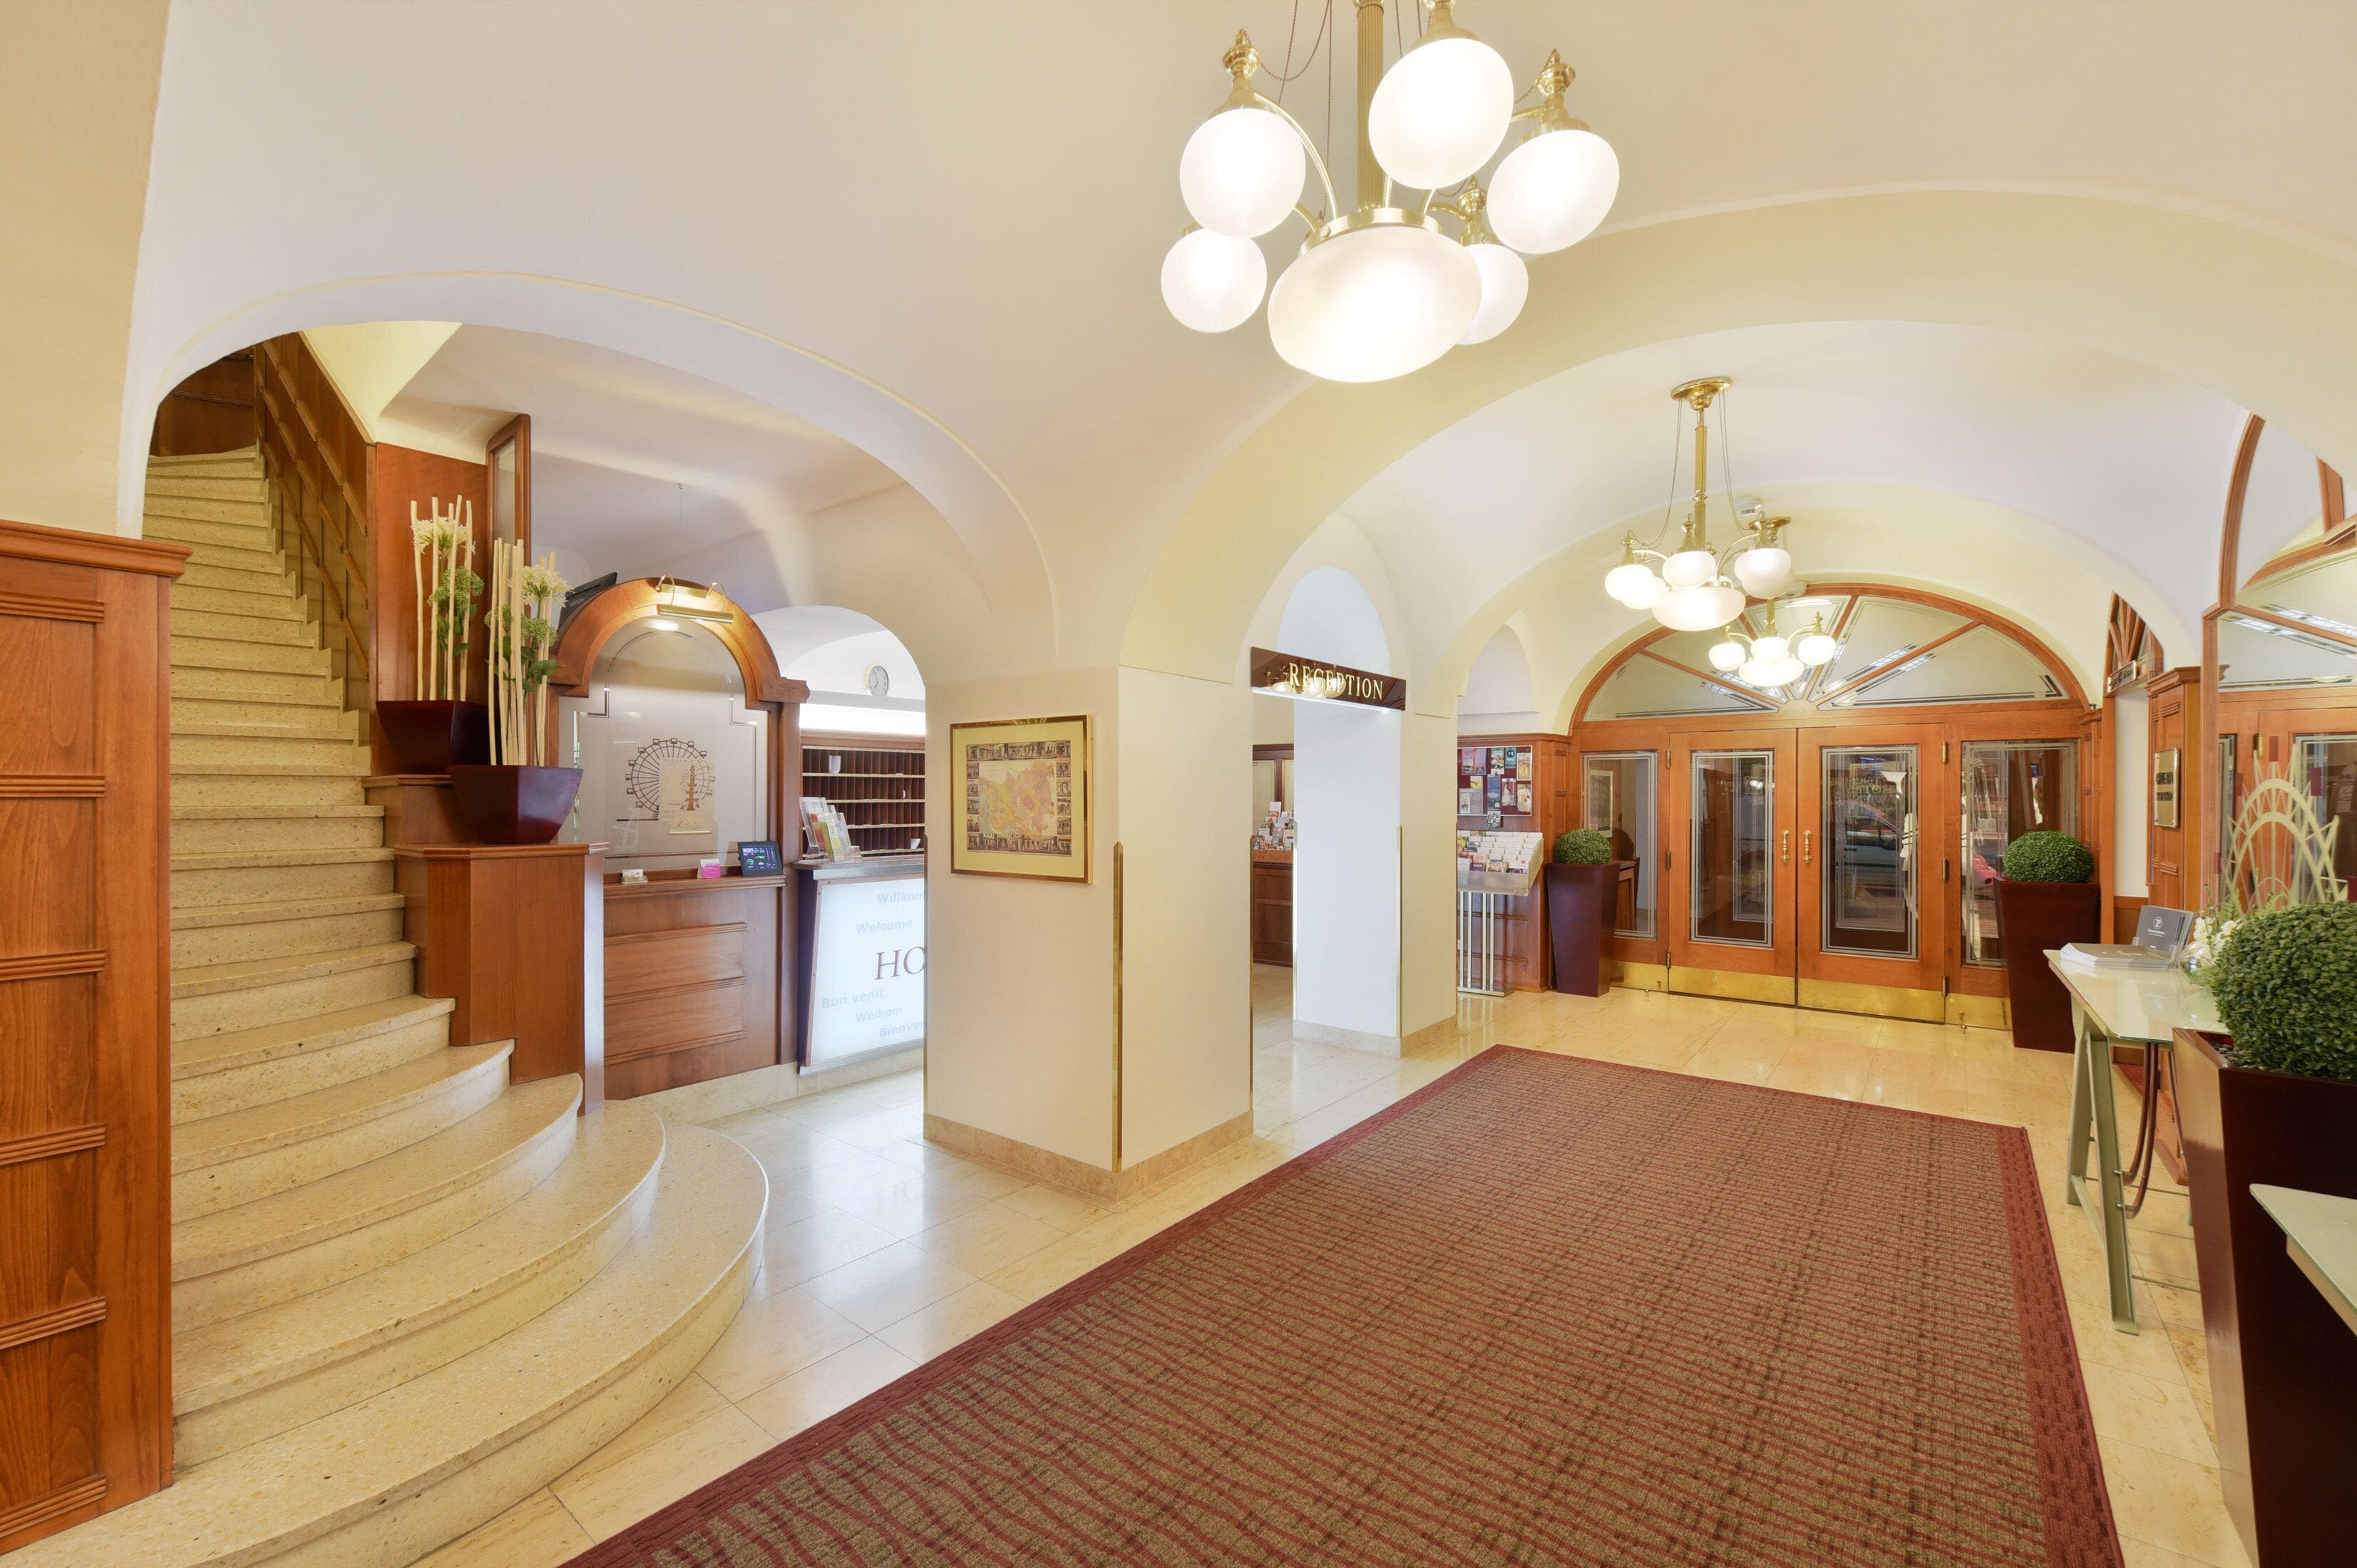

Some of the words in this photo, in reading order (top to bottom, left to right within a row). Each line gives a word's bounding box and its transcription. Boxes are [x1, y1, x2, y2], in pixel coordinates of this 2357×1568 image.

[1289, 663, 1383, 700] RECEPTION
[856, 919, 913, 934] Welcome
[874, 947, 924, 980] HO
[821, 996, 847, 1009] Bun
[853, 989, 884, 1004] venit
[856, 1006, 903, 1022] Welkom
